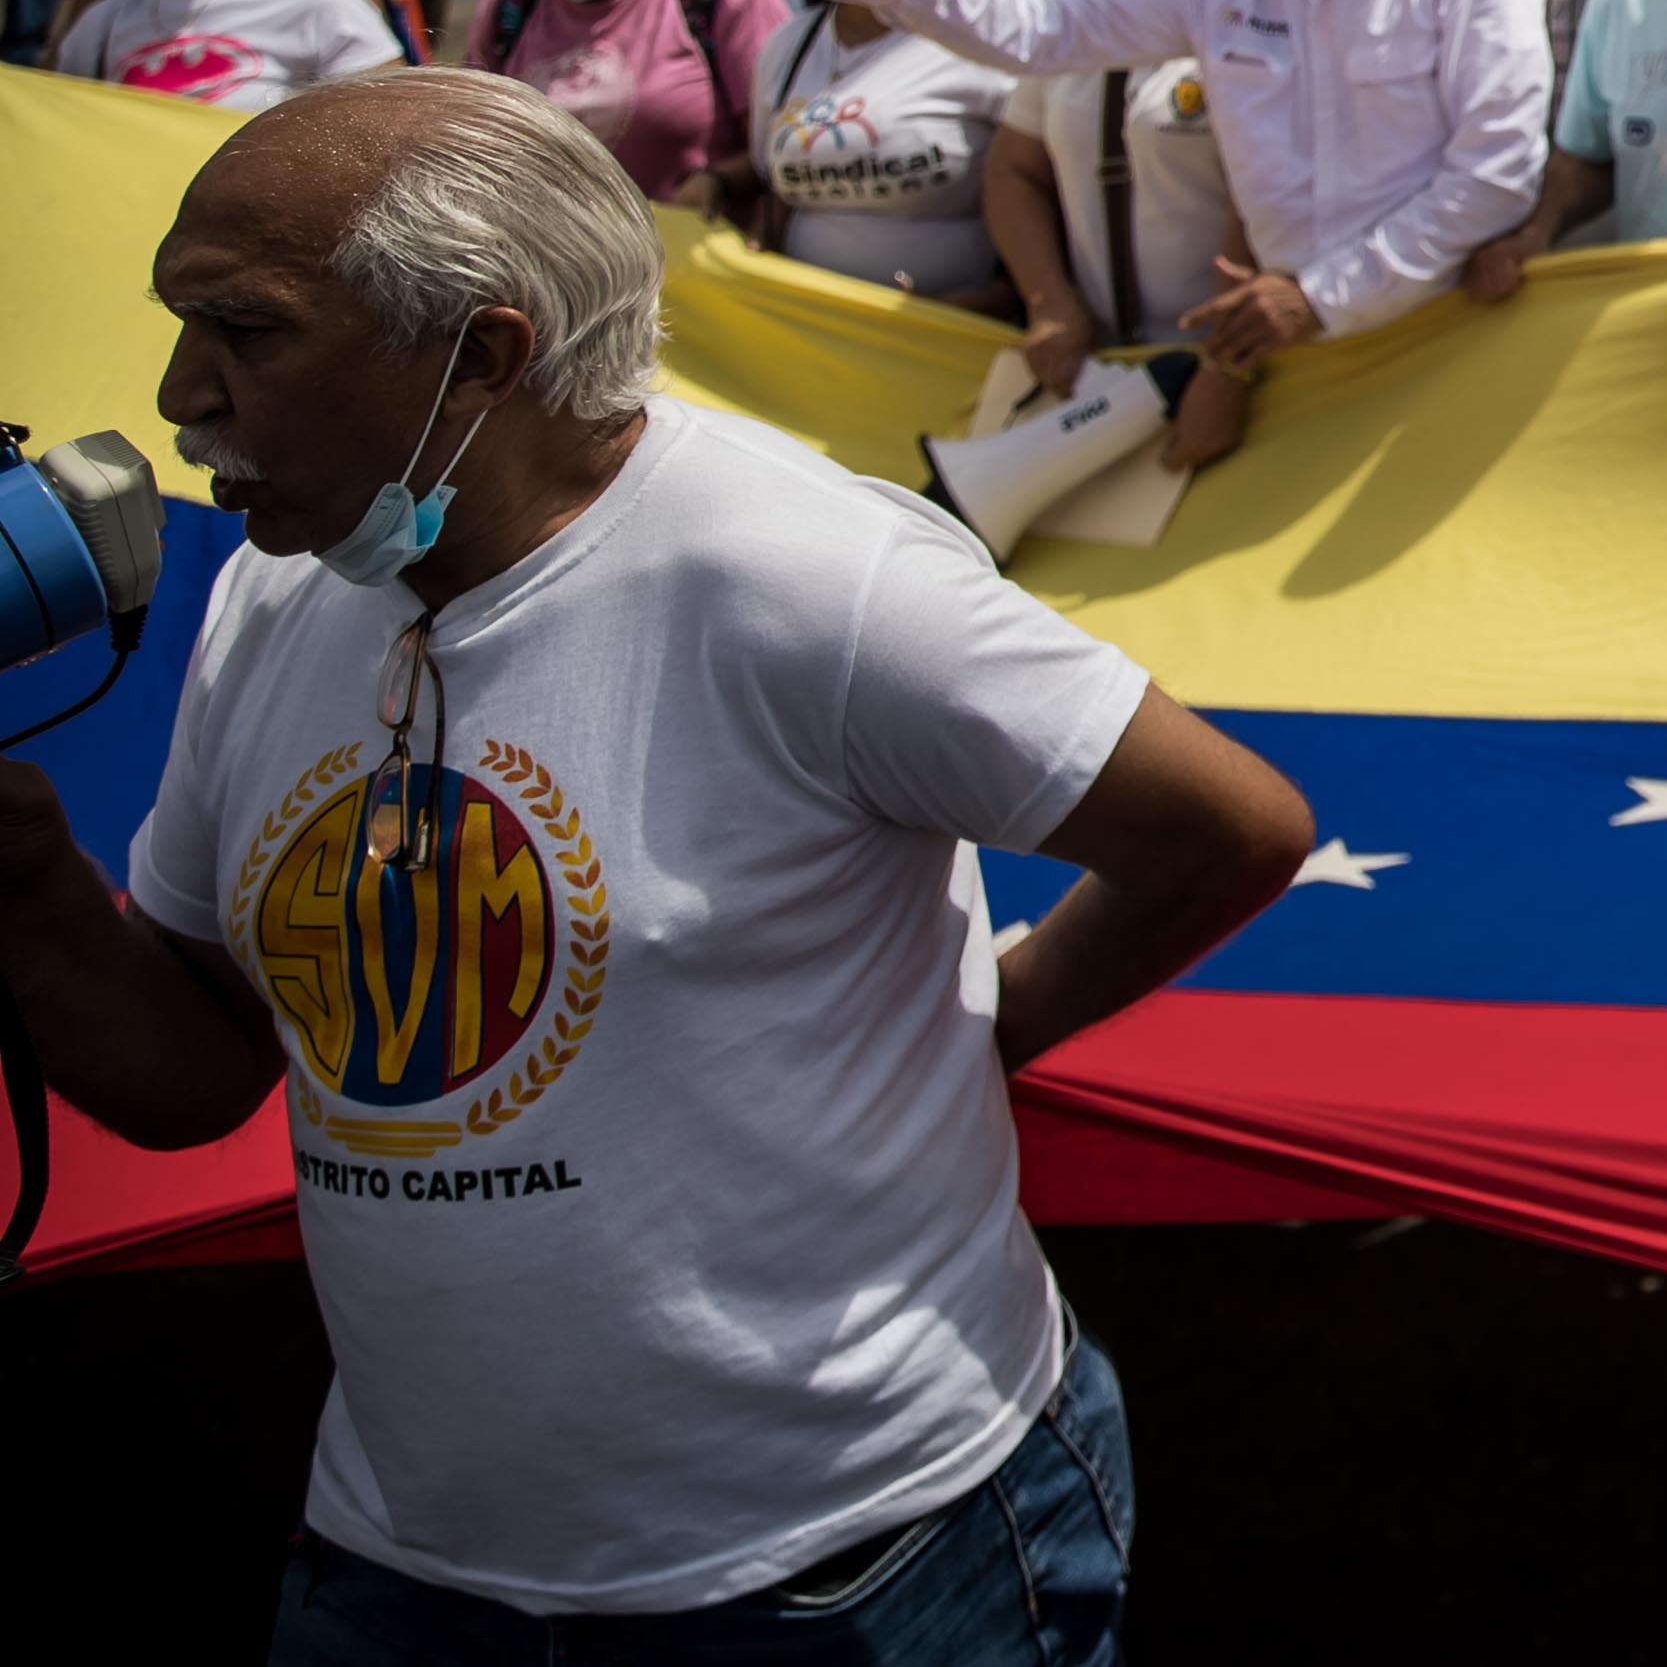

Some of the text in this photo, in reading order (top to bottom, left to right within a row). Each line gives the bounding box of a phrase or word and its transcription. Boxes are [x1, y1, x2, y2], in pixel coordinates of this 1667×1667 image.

[783, 144, 944, 183] Sindical
[257, 790, 549, 1086] SVM
[296, 1150, 582, 1202] STRITO CAPITAL
